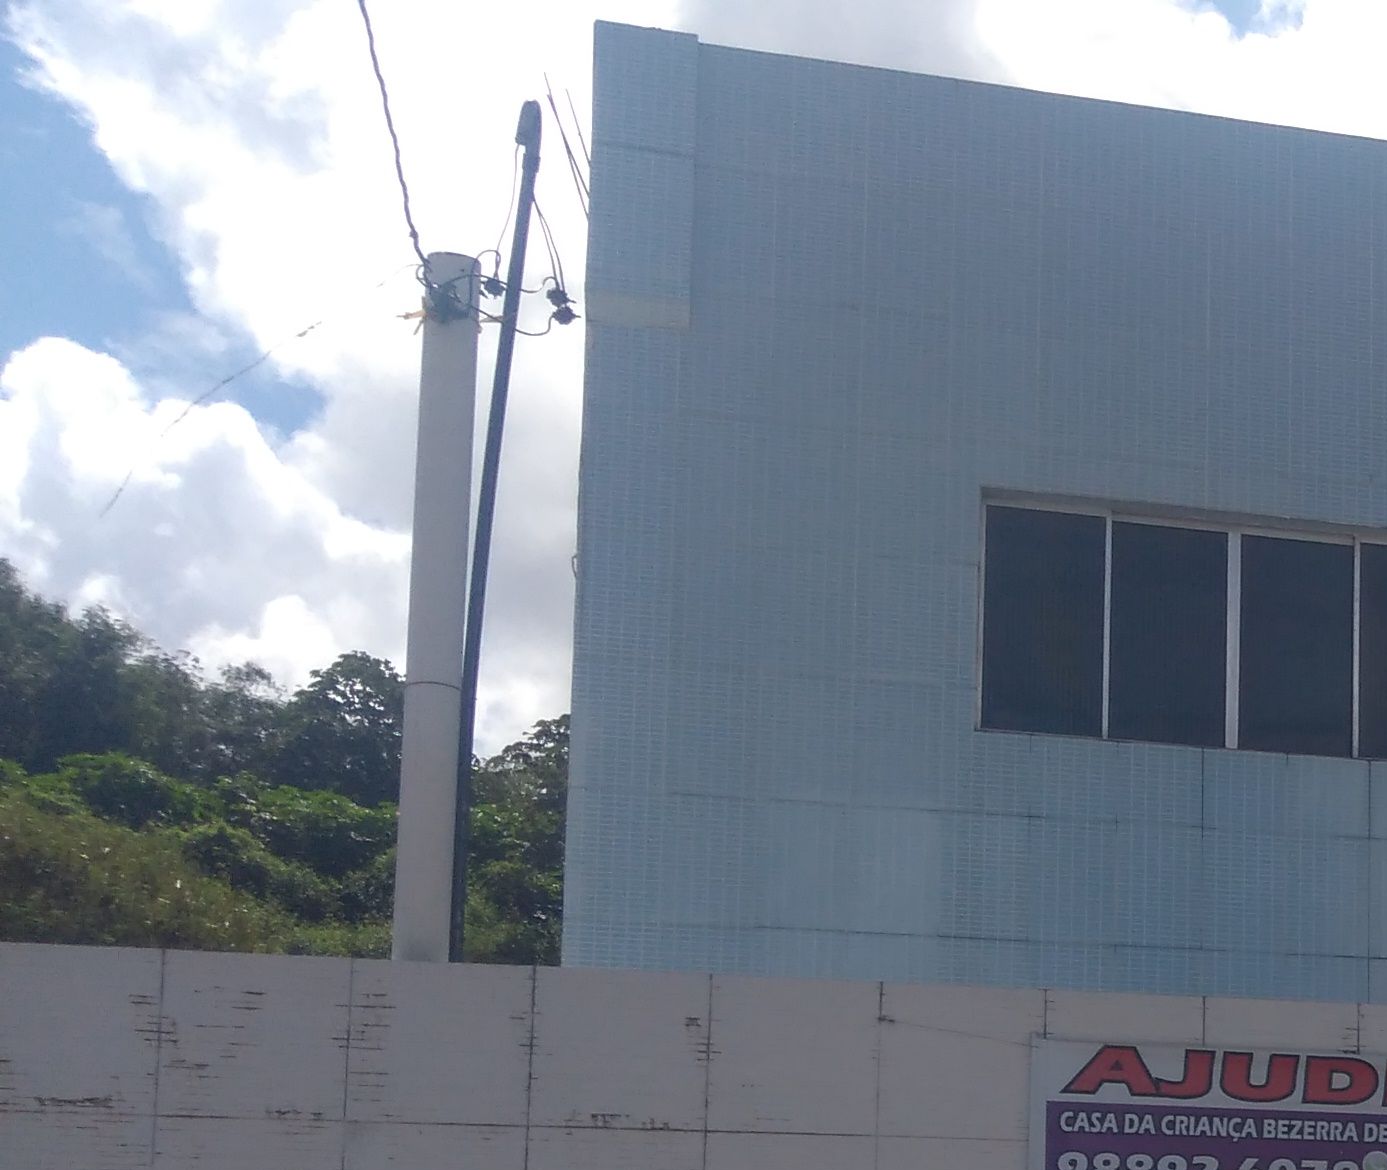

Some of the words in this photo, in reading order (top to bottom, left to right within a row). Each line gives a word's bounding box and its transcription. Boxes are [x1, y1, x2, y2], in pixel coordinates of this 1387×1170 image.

[1059, 1111, 1118, 1134] CASA
[1124, 1113, 1156, 1136] DA
[1161, 1115, 1257, 1142] CRIANÇA
[1263, 1118, 1359, 1142] BEZERRA
